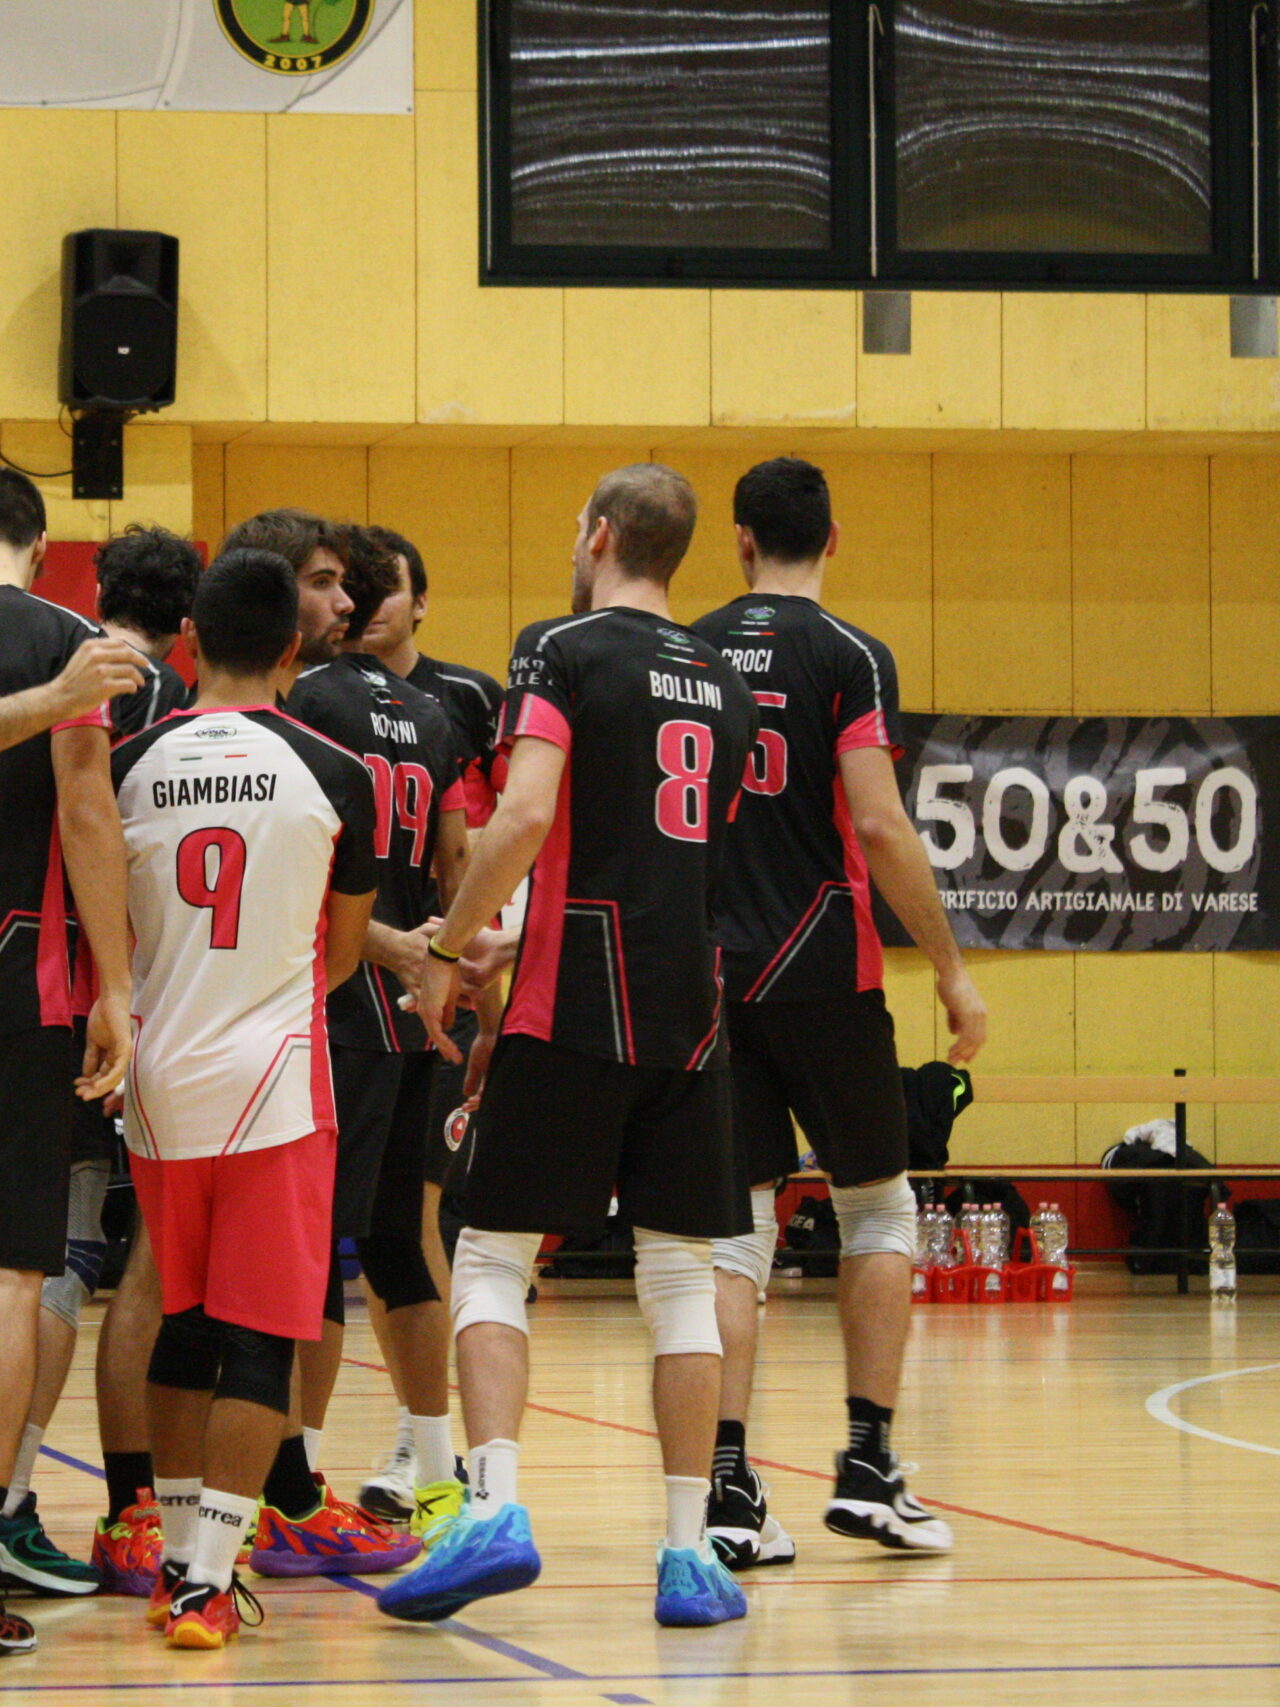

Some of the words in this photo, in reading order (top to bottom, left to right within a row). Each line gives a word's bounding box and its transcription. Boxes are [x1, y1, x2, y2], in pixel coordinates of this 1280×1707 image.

[264, 54, 323, 71] 2007
[649, 670, 722, 711] BOLLINI
[152, 773, 278, 809] GIAMBIASI
[363, 753, 434, 868] 19
[655, 719, 714, 843] 8
[916, 764, 1258, 873] 50&50
[176, 826, 247, 951] 9
[1025, 890, 1155, 912] ARTIGIANALE
[1162, 892, 1183, 911] DI
[1191, 892, 1259, 912] VARESE
